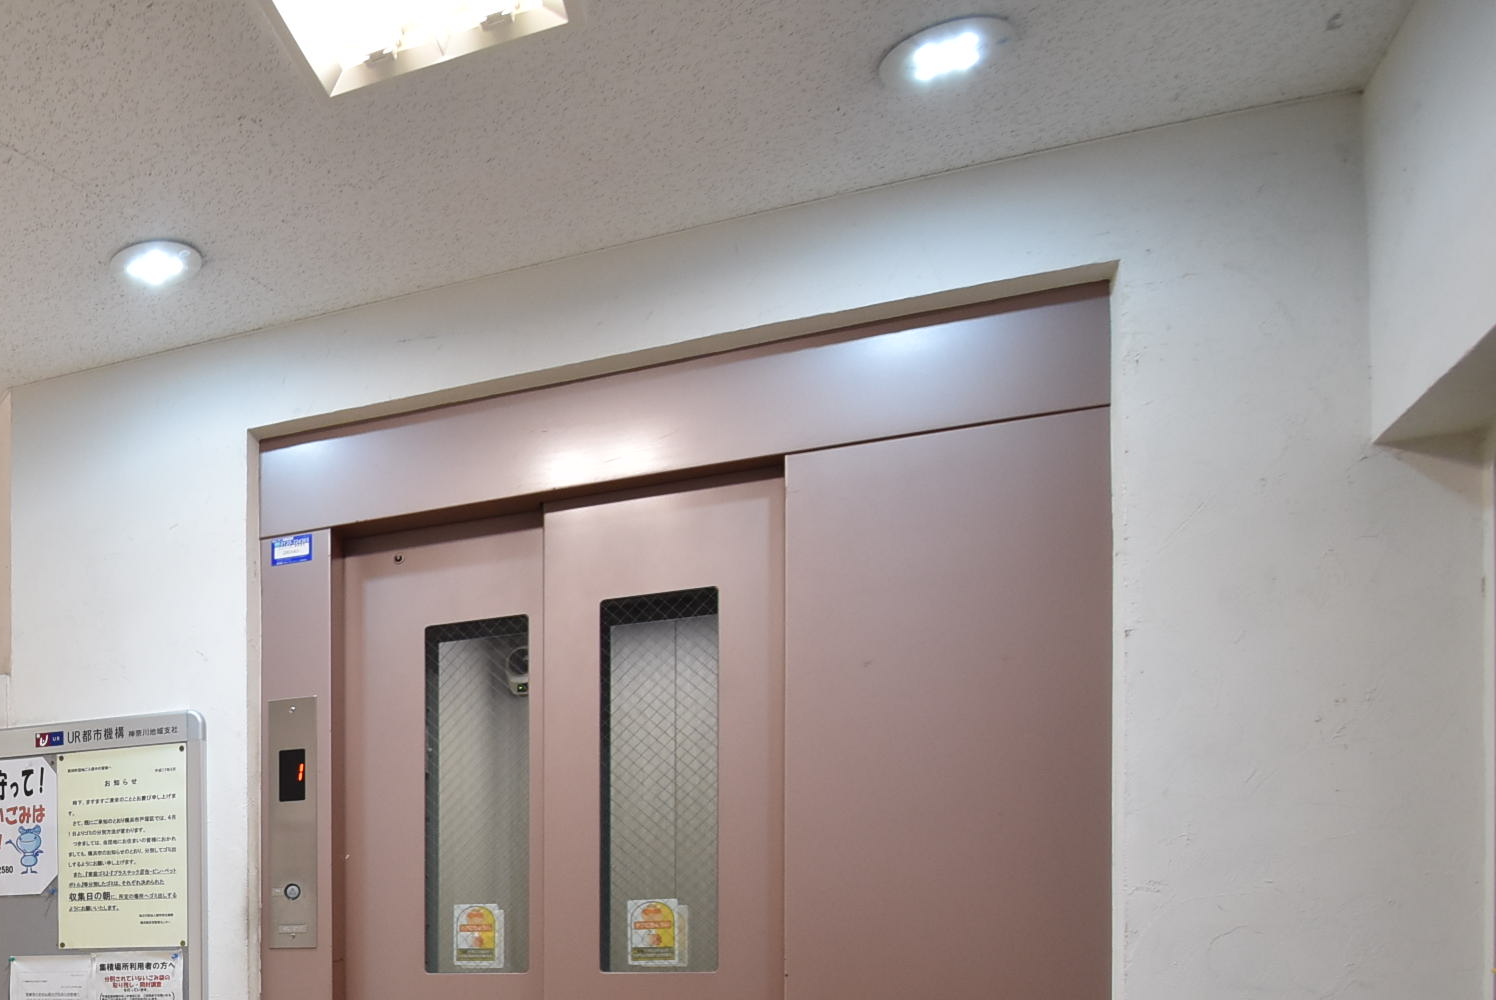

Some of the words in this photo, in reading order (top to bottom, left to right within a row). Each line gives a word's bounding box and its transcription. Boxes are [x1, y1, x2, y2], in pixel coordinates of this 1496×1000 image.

[67, 726, 124, 744] UR都市機構
[128, 726, 178, 738] 神奈川地域支社
[298, 763, 304, 781] 1
